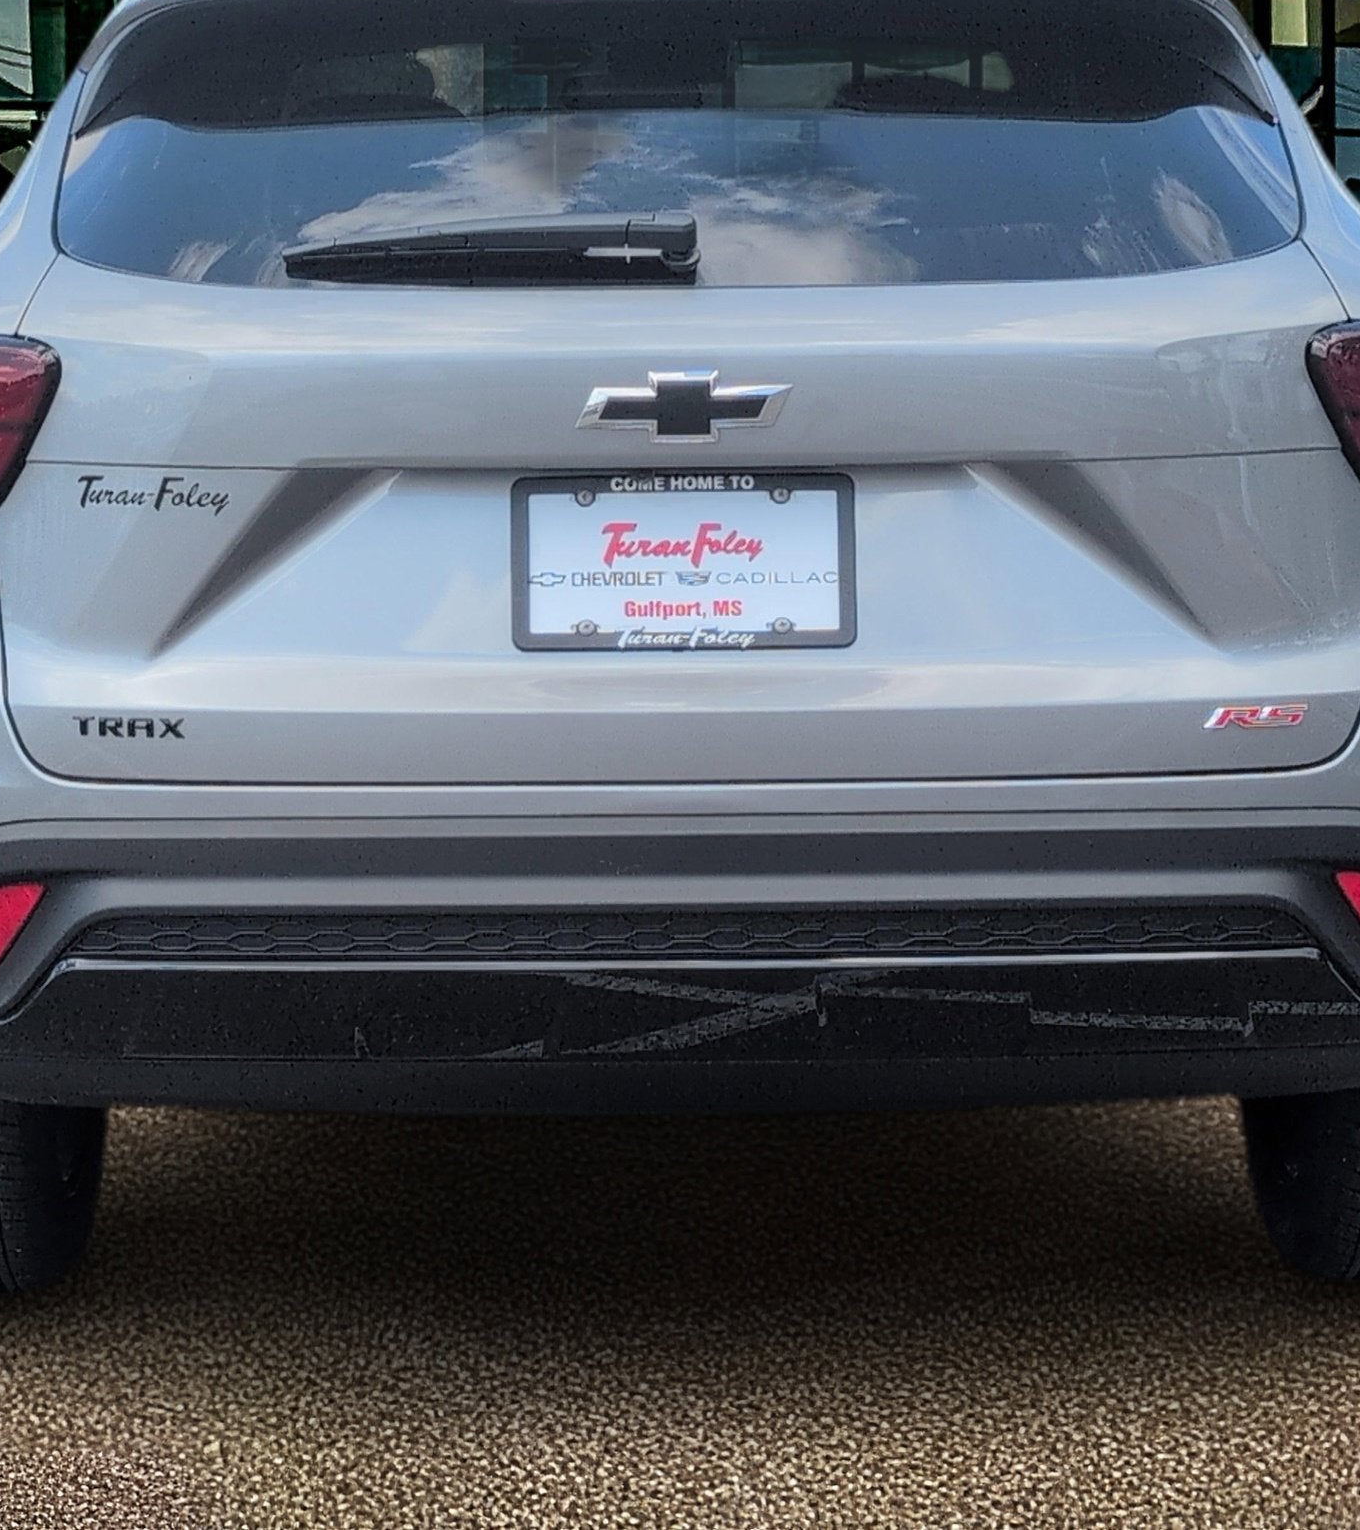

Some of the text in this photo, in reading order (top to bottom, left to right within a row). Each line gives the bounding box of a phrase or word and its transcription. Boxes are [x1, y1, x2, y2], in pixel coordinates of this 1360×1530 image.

[610, 473, 755, 492] COME HOME TO
[572, 571, 839, 587] CHEVROLET CADILLAC
[624, 600, 742, 620] Gulfport, MS
[1203, 703, 1308, 729] RS
[73, 716, 185, 739] TRAX
